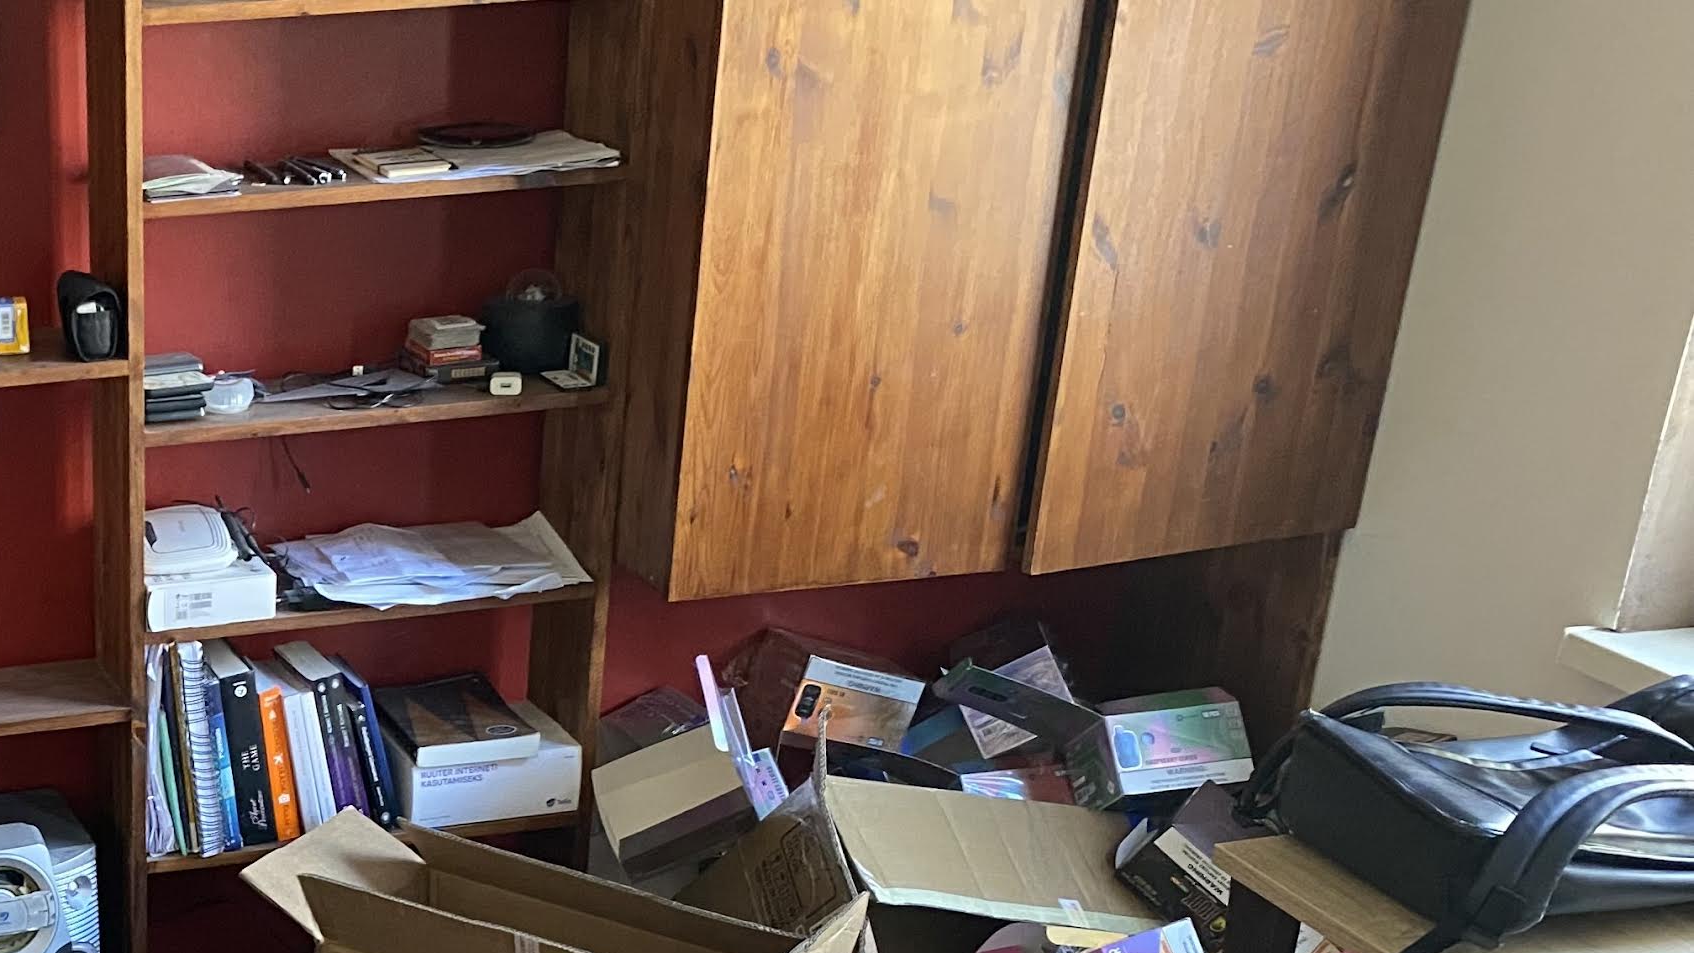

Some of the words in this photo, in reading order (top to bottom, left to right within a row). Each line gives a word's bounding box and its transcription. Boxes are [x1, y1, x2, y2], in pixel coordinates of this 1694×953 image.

[241, 750, 251, 770] THE
[249, 744, 261, 772] GAME
[420, 768, 454, 779] RUUTER
